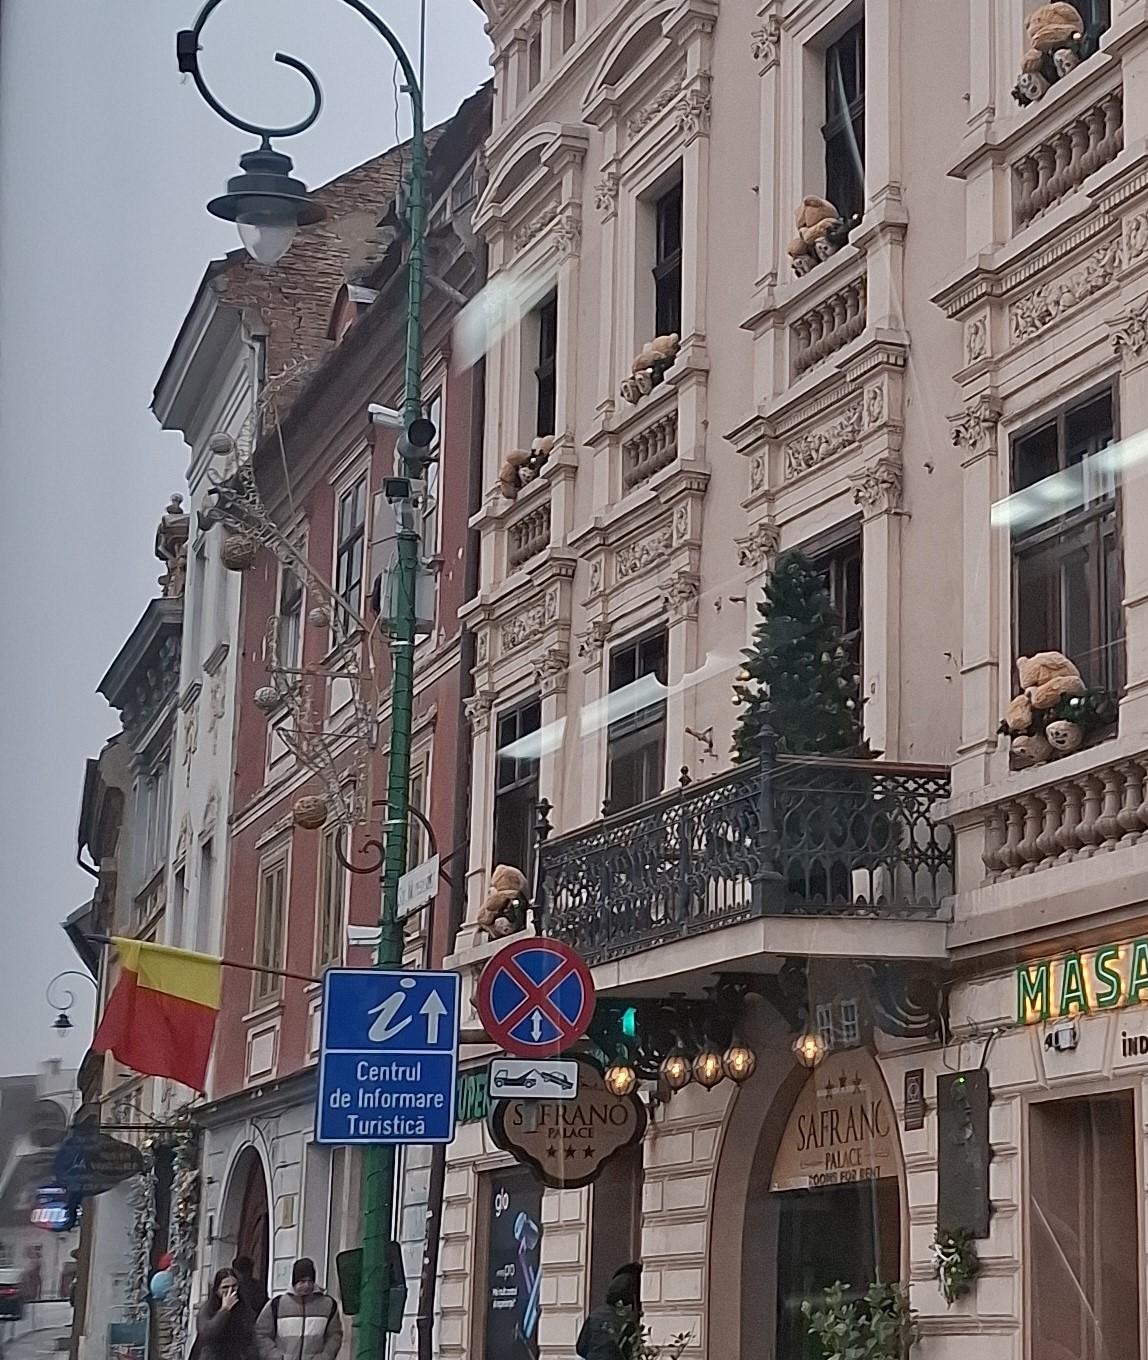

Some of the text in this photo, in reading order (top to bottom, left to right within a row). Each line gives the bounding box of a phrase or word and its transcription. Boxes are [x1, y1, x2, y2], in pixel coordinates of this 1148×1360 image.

[356, 1061, 421, 1081] Centrul
[329, 1087, 444, 1108] de Informare
[346, 1114, 425, 1135] Turistică
[512, 1103, 629, 1126] SFRANO
[548, 1126, 594, 1138] PALACE
[825, 1148, 862, 1170] PALACE
